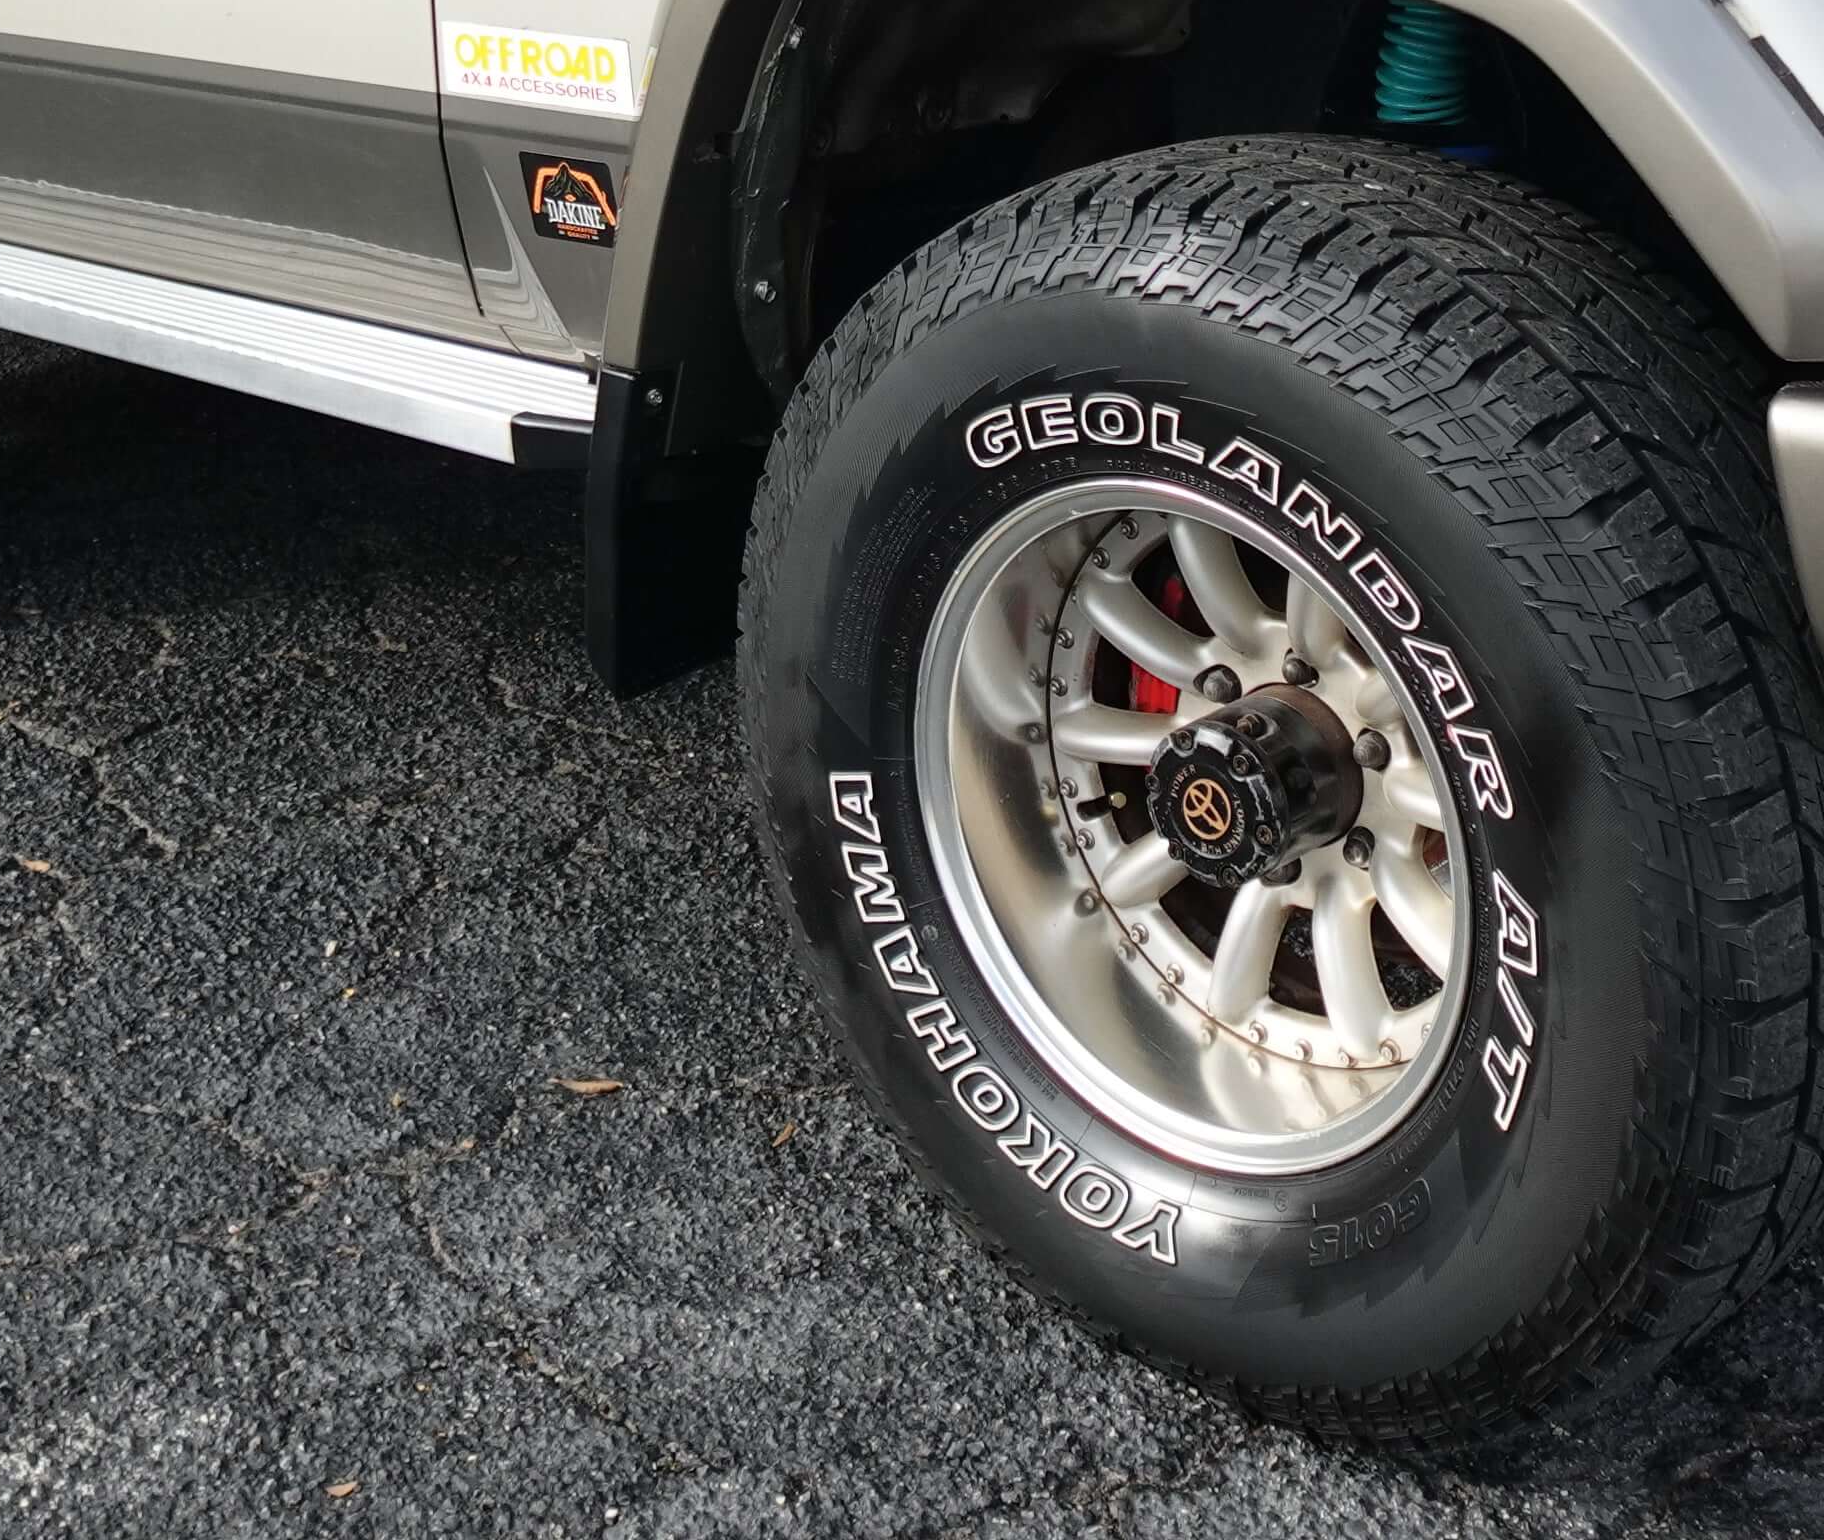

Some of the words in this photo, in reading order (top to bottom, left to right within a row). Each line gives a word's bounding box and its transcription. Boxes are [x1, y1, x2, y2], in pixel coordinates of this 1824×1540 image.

[498, 76, 618, 103] ACCESSORIES
[544, 196, 606, 230] DAKINE
[965, 392, 1514, 821] GEOLANDAR
[1482, 867, 1540, 1134] A/T
[828, 772, 1182, 1266] YOKOHAMA
